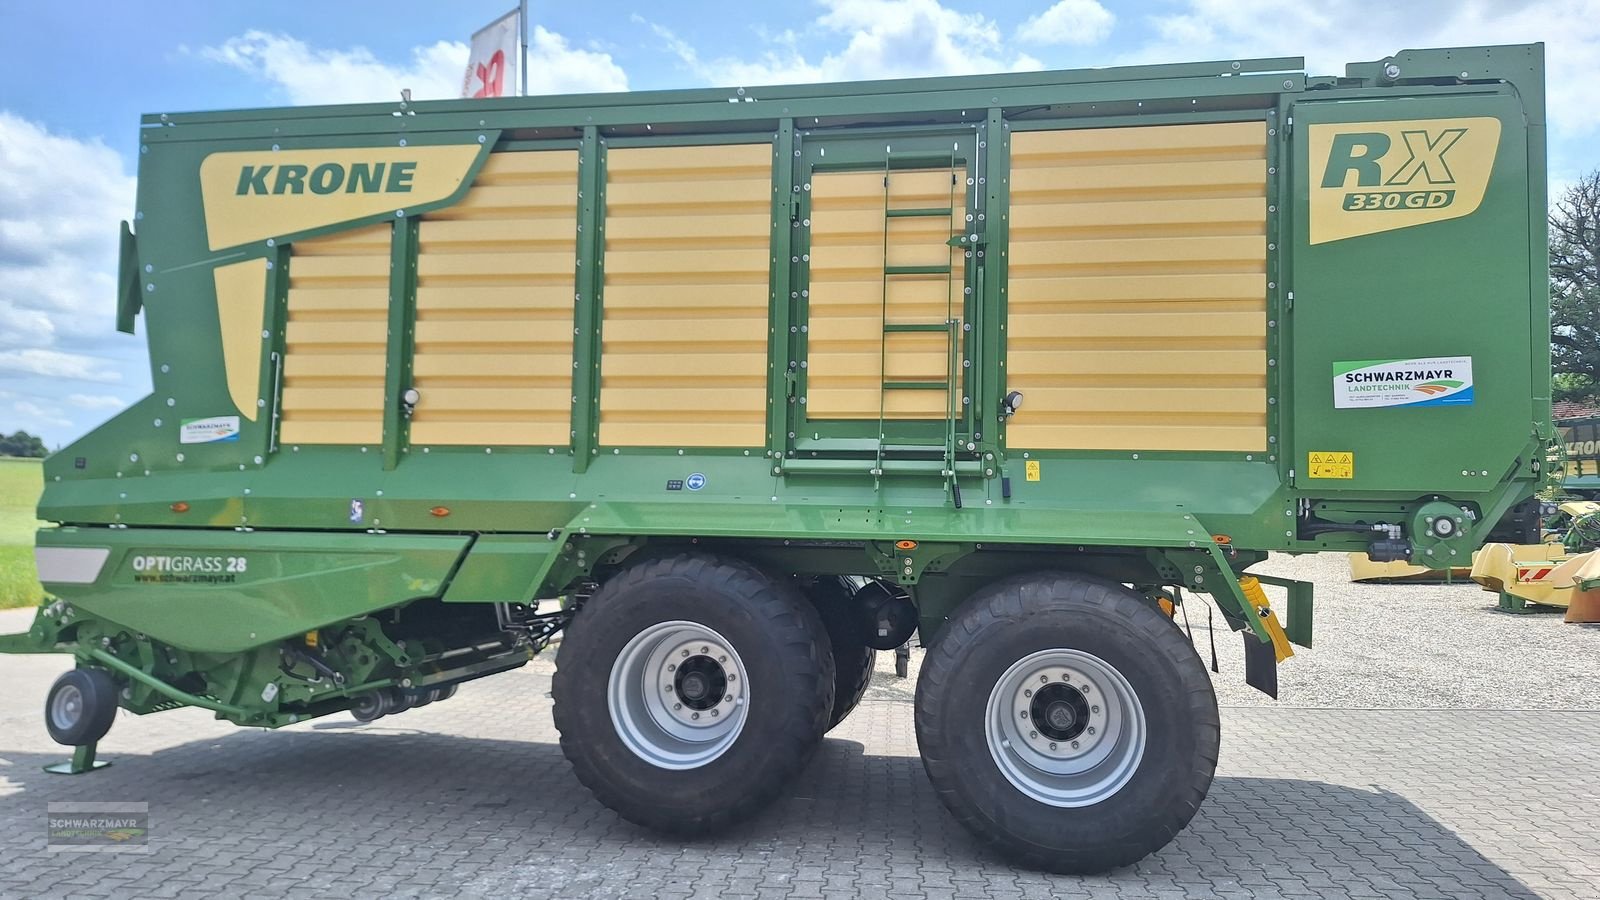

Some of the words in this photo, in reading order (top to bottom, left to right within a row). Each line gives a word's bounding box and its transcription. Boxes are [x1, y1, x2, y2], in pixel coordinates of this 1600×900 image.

[1320, 128, 1469, 188] RX
[235, 161, 418, 196] KRONE
[1350, 194, 1400, 209] 330
[1405, 192, 1448, 207] GD
[1345, 369, 1453, 382] SCHWARZMAYR
[1348, 384, 1410, 392] LANDTECHNIK
[133, 556, 222, 572] OPTIGRASS
[226, 557, 247, 572] 28
